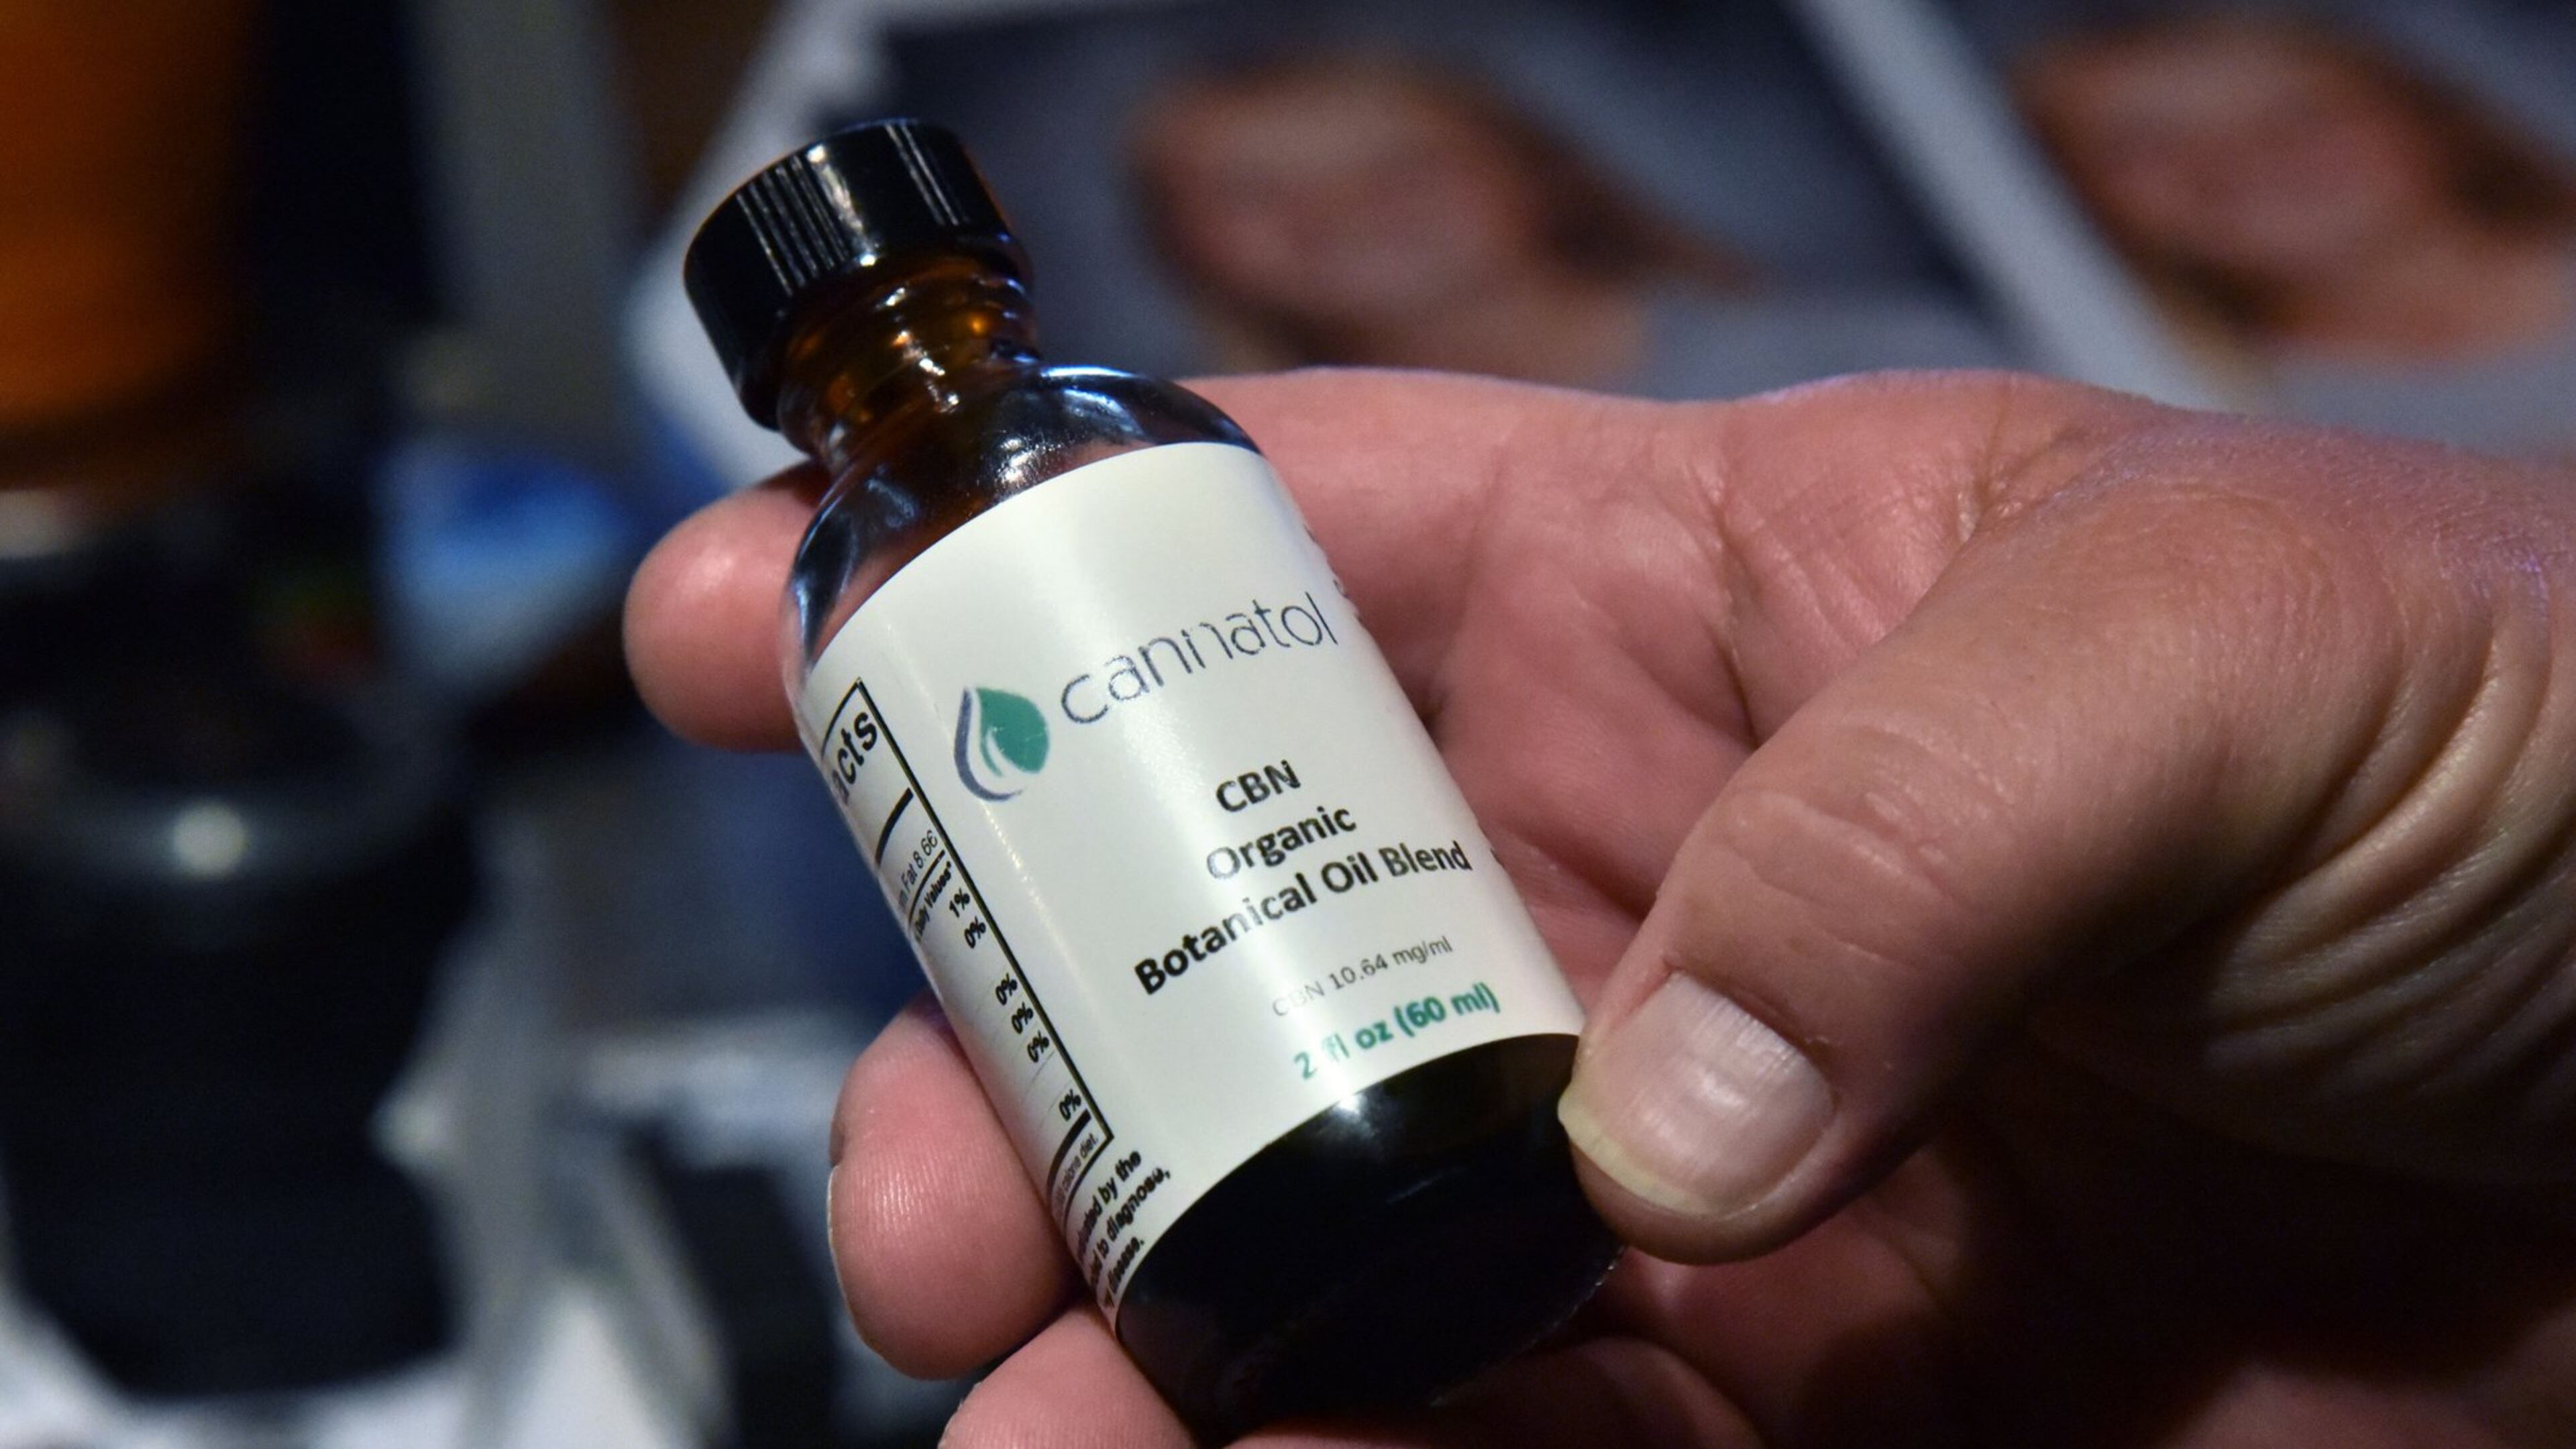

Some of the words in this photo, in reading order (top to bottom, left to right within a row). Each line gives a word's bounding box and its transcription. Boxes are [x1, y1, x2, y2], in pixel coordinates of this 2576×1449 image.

[1061, 593, 1338, 724] cannatol
[1216, 760, 1301, 812] CBN
[1208, 806, 1356, 879] Organic
[949, 888, 970, 918] 1%
[1134, 873, 1318, 995] Botanical
[1320, 852, 1379, 894] Oil
[1379, 840, 1472, 877] Blend
[965, 916, 986, 949] 0%
[996, 973, 1018, 1006] 0%
[1273, 980, 1324, 1017] CBN
[1329, 953, 1388, 990] 10.64
[1393, 935, 1452, 965] mg/ml
[1012, 1002, 1034, 1034] 0%
[1294, 1052, 1318, 1079] 2
[1322, 1033, 1350, 1062] fl
[1356, 1021, 1393, 1050] oz
[1393, 996, 1446, 1037] (60
[1451, 981, 1501, 1014] ml)
[1027, 1030, 1050, 1063] 0%
[1059, 1089, 1081, 1122] 0%
[1097, 1177, 1118, 1205] by
[1115, 1151, 1141, 1182] the
